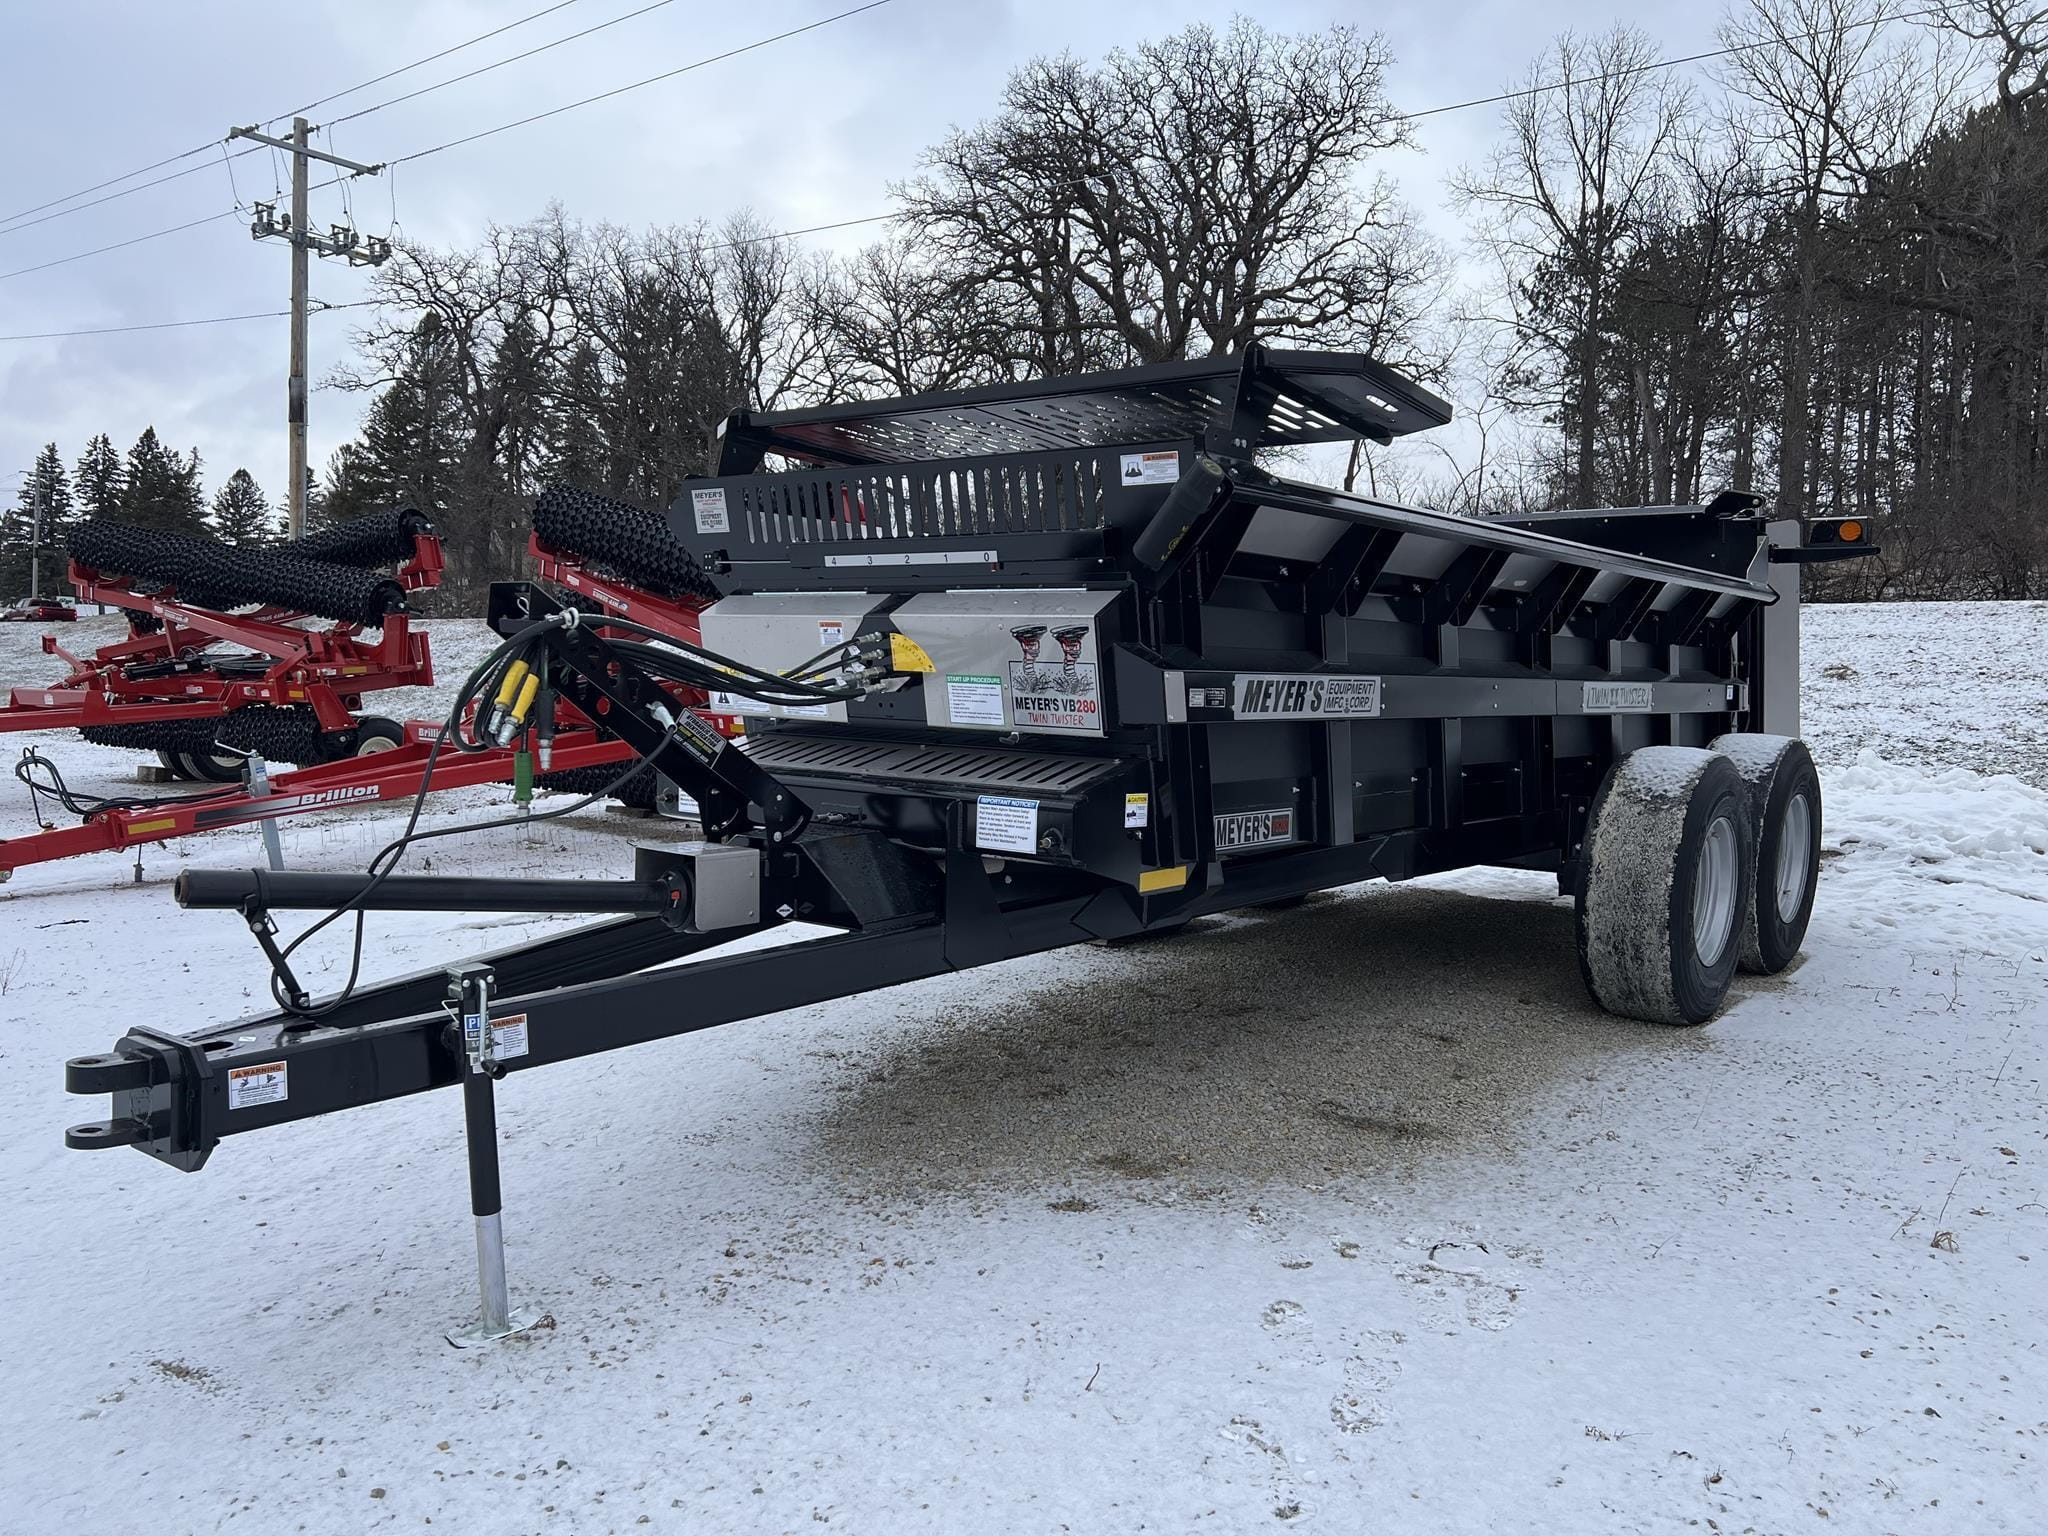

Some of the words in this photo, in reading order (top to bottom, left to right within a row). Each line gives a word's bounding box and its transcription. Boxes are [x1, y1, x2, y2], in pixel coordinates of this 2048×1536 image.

[831, 557, 837, 565] 4
[867, 556, 873, 565] 3
[904, 554, 910, 564] 2
[943, 553, 948, 562] 1
[983, 552, 990, 562] 0
[1328, 682, 1373, 695] EQUIPMENT
[1241, 679, 1325, 713] MEYER'S
[1325, 696, 1345, 708] MFG.
[1350, 696, 1371, 708] CORP.
[1015, 696, 1060, 712] MEYER'S
[1062, 698, 1096, 714] VB280
[1028, 712, 1048, 724] TWIN
[1050, 713, 1084, 726] TWISTER
[301, 784, 379, 805] Brillion
[980, 798, 1011, 806] IMPORTANT
[1216, 814, 1271, 847] MEYER'S
[243, 1064, 282, 1078] WARNING
